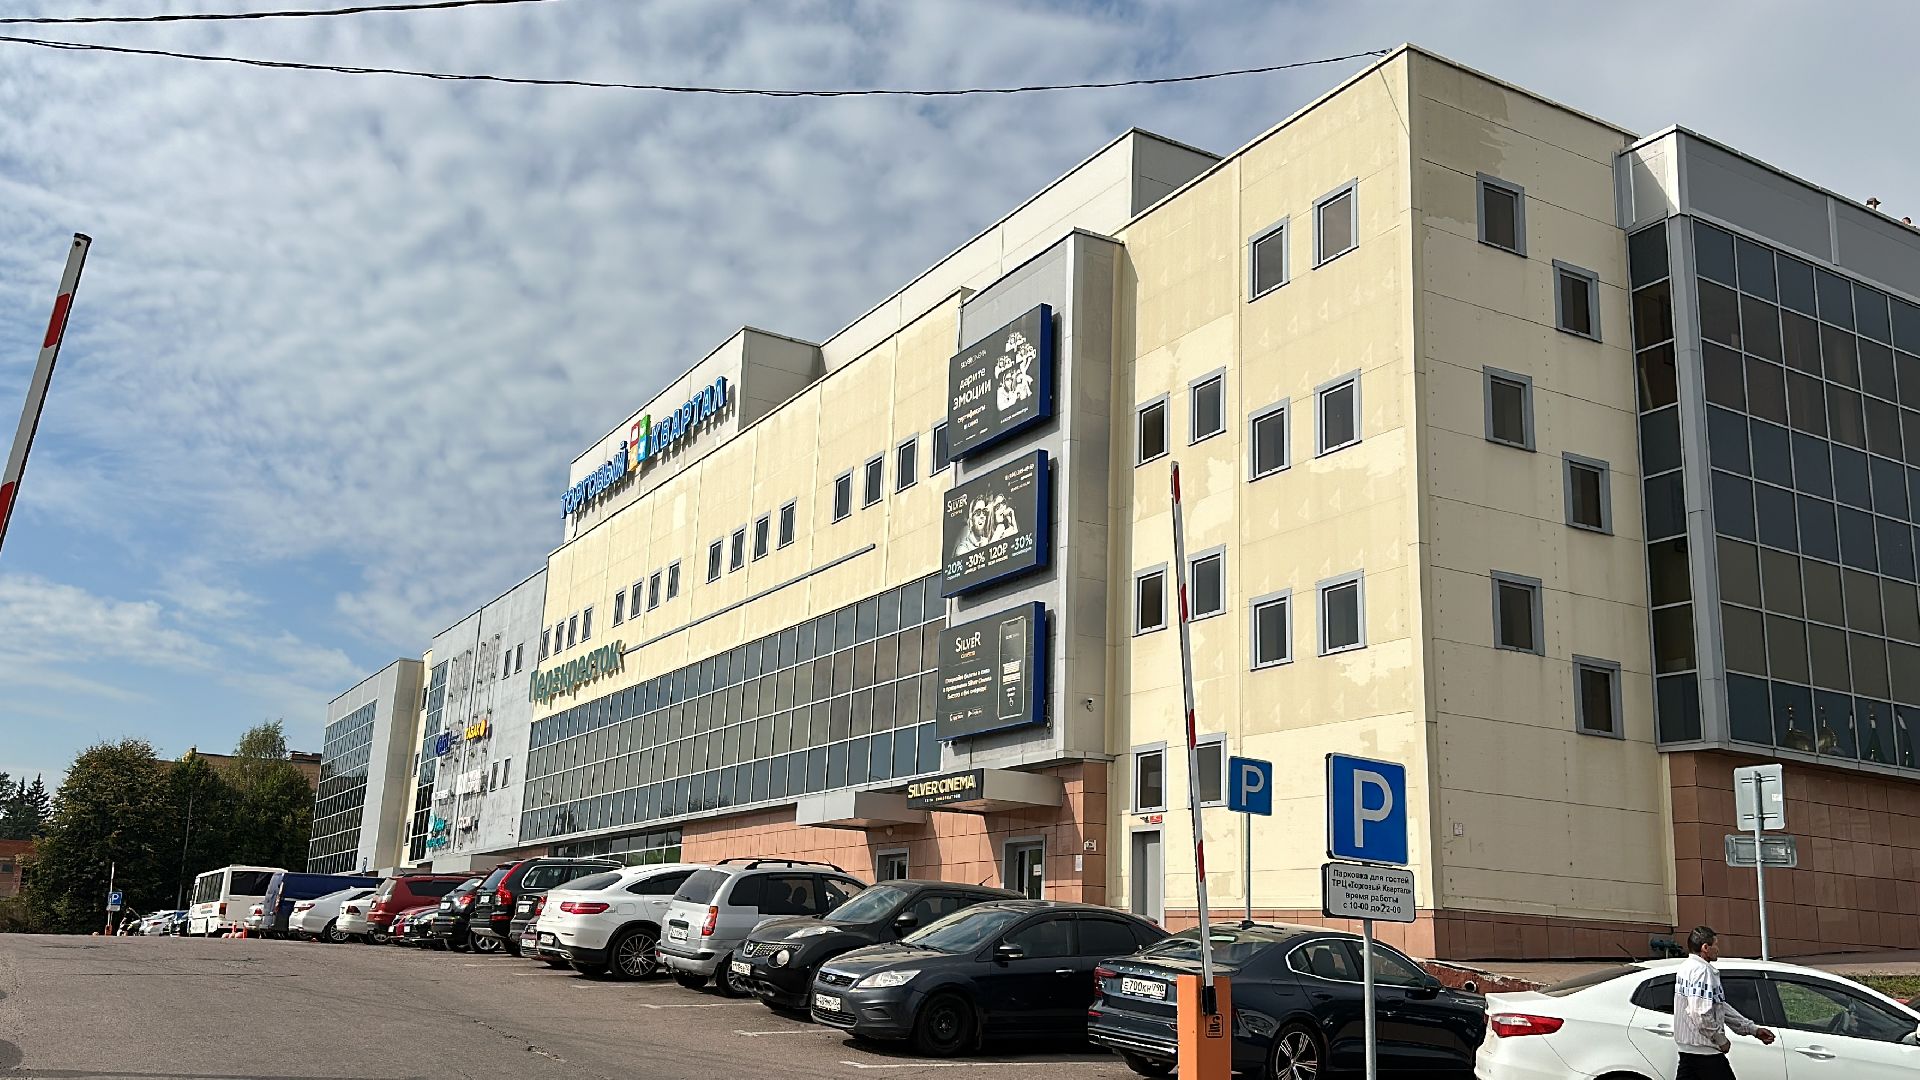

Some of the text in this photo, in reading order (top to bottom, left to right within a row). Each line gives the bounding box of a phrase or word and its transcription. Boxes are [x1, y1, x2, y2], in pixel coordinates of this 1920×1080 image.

[960, 368, 985, 391] дарите
[953, 379, 991, 411] ЭМОЦИИ
[561, 376, 728, 519] ТОРГОВЫЙ КВАРТАЛ
[945, 560, 963, 575] -20%
[966, 551, 986, 568] -30%
[1011, 533, 1033, 551] -30%
[1242, 764, 1265, 806] P
[1353, 769, 1393, 848] P
[1331, 878, 1348, 889] ТРЦ
[1333, 869, 1369, 880] Парковка
[1385, 875, 1410, 884] гостей
[1345, 892, 1399, 904] время работы
[1349, 902, 1369, 911] 10-00
[1370, 905, 1380, 913] до
[1381, 904, 1402, 914] 22-00
